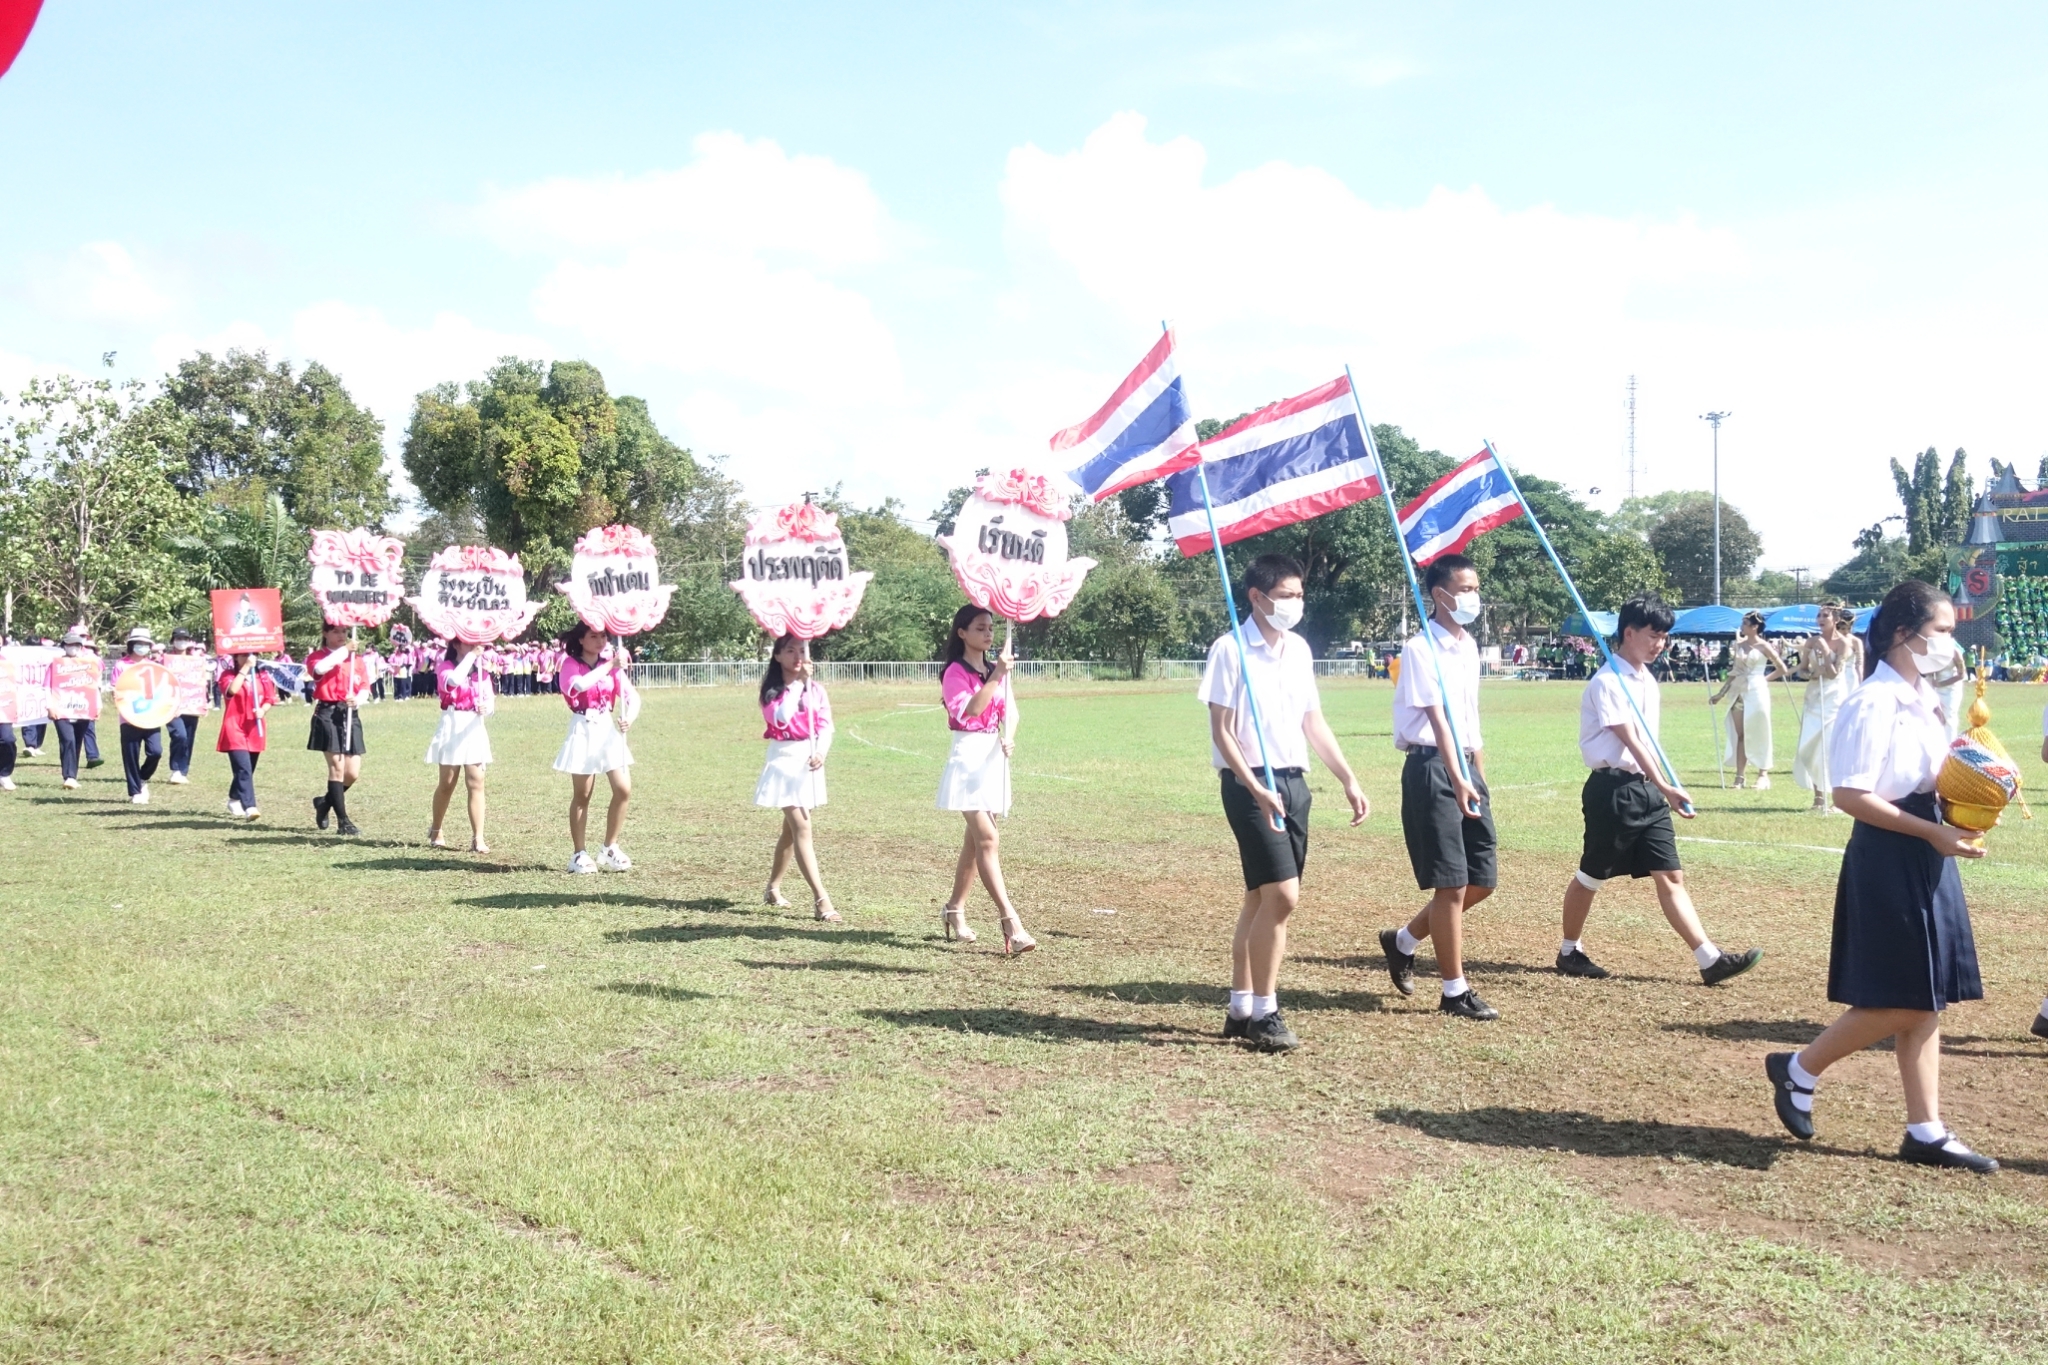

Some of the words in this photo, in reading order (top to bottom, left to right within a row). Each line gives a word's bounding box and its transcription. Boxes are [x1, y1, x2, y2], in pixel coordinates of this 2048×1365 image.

[2002, 507, 2048, 523] RAT
[978, 515, 1048, 565] เรียนดี
[335, 570, 354, 586] TO
[360, 573, 379, 588] BE
[748, 546, 843, 589] ประพฤติดี
